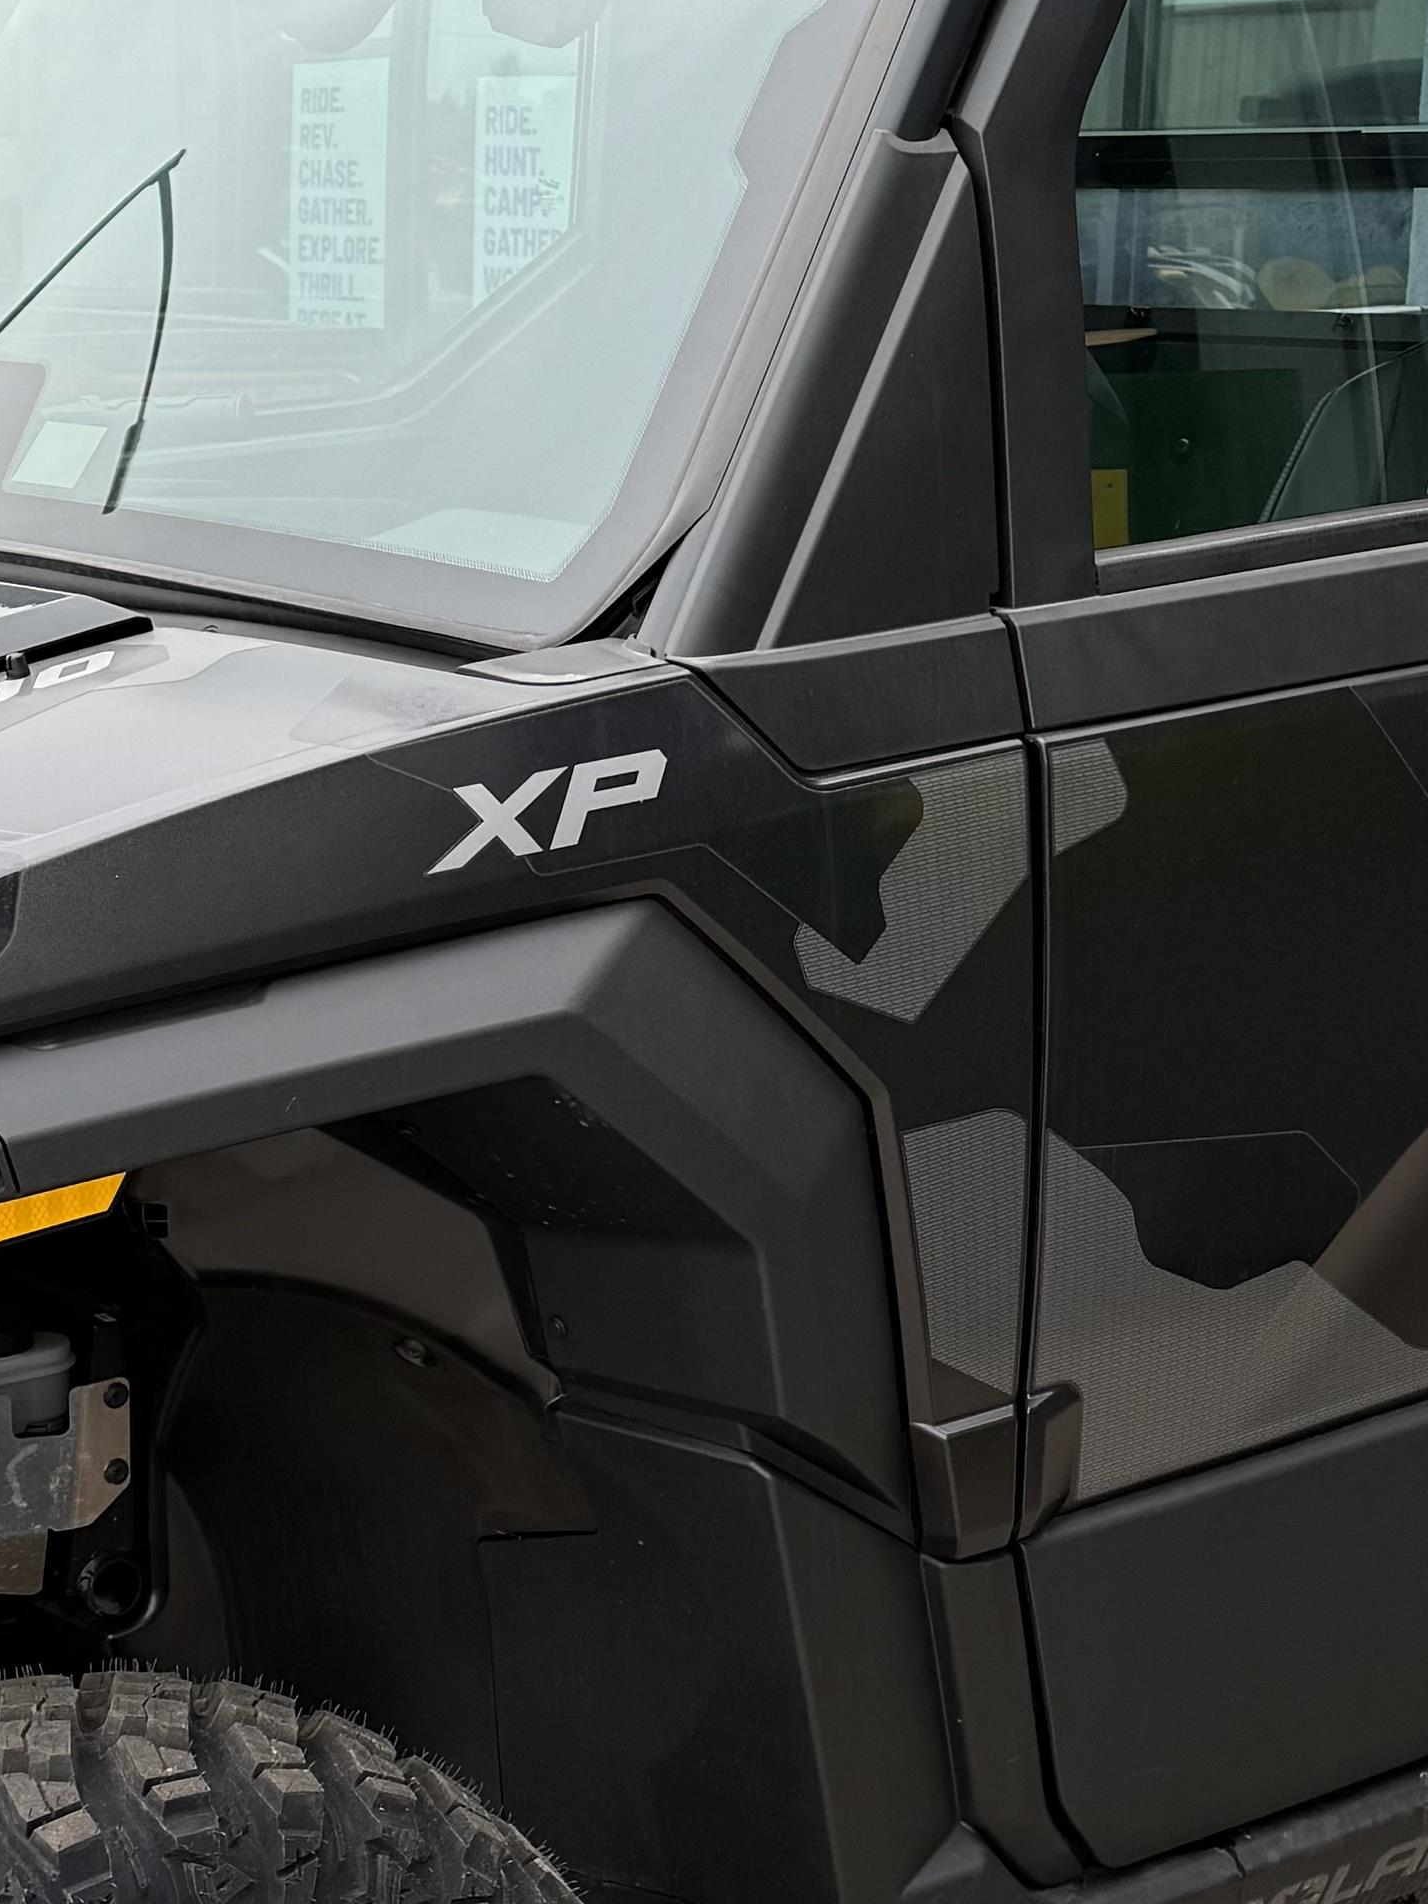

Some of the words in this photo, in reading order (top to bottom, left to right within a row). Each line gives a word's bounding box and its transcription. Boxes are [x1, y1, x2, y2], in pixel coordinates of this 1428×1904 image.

[301, 87, 346, 114] RIDE.
[485, 105, 538, 136] RIDE.
[300, 123, 339, 150] REV.
[298, 159, 364, 189] CHASE.
[484, 147, 545, 177] HUNT.
[298, 197, 374, 227] GATHER.
[425, 748, 668, 875] XP
